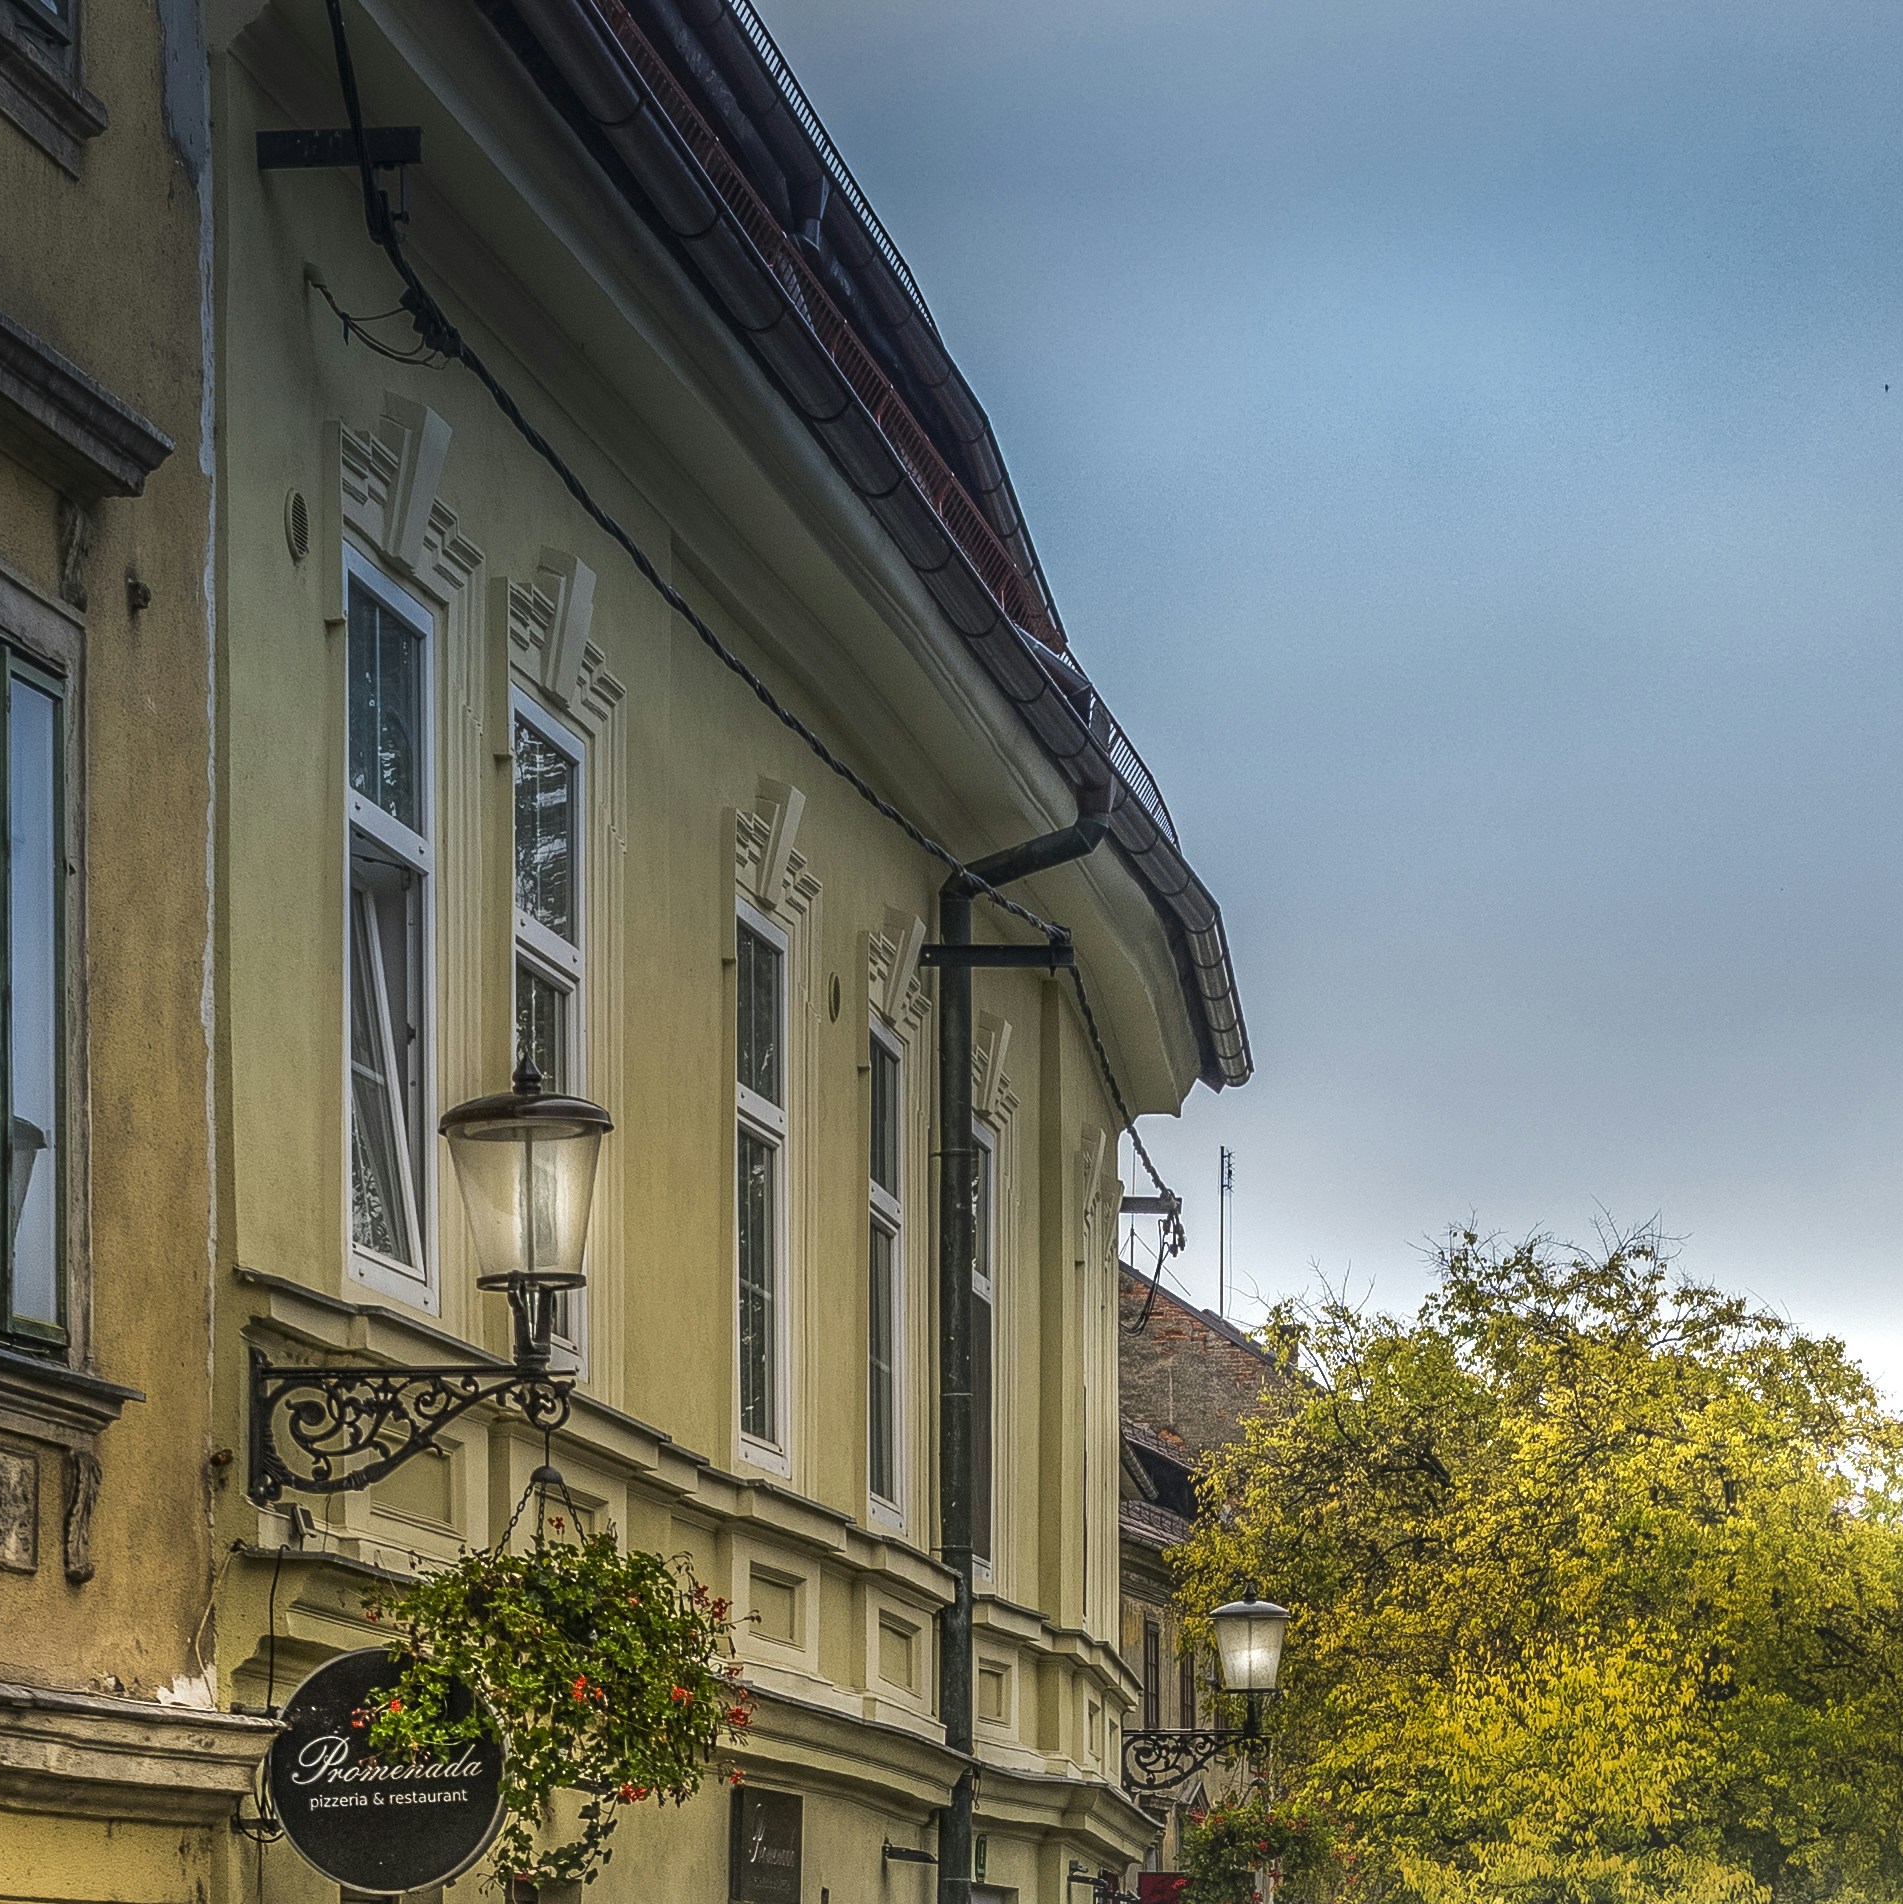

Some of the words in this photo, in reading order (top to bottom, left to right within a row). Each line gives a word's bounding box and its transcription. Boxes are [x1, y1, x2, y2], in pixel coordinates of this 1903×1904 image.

[291, 1735, 483, 1785] Promenada
[309, 1793, 368, 1811] pizzeria
[373, 1792, 385, 1805] &
[389, 1789, 468, 1804] restaurant
